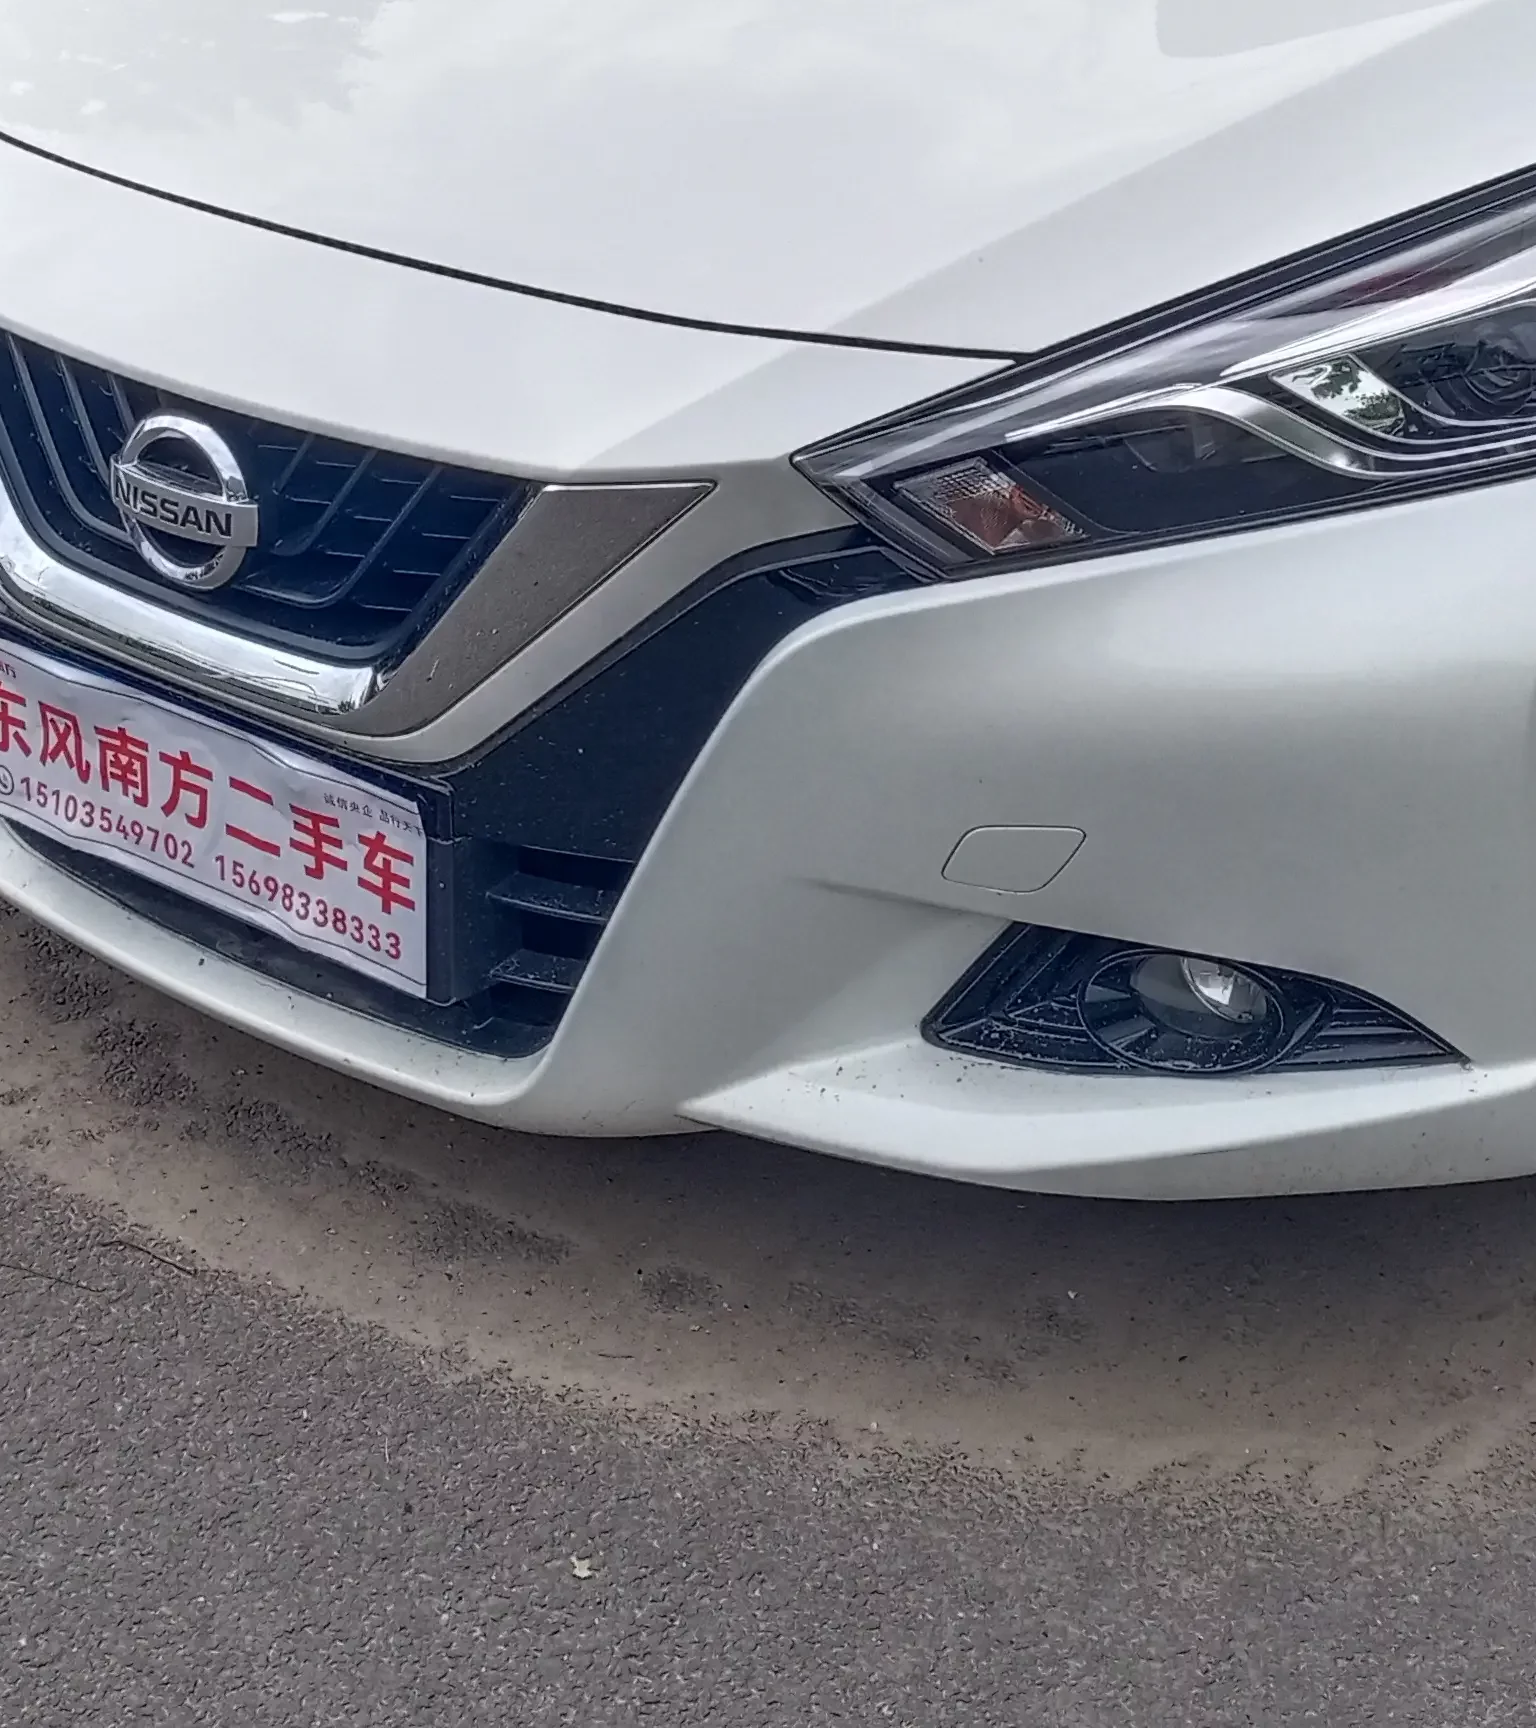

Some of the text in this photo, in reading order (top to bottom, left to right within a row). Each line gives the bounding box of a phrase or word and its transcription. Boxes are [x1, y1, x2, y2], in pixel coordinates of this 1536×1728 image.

[113, 475, 233, 538] NISSAN
[20, 776, 402, 960] 15103549702 15698338333
